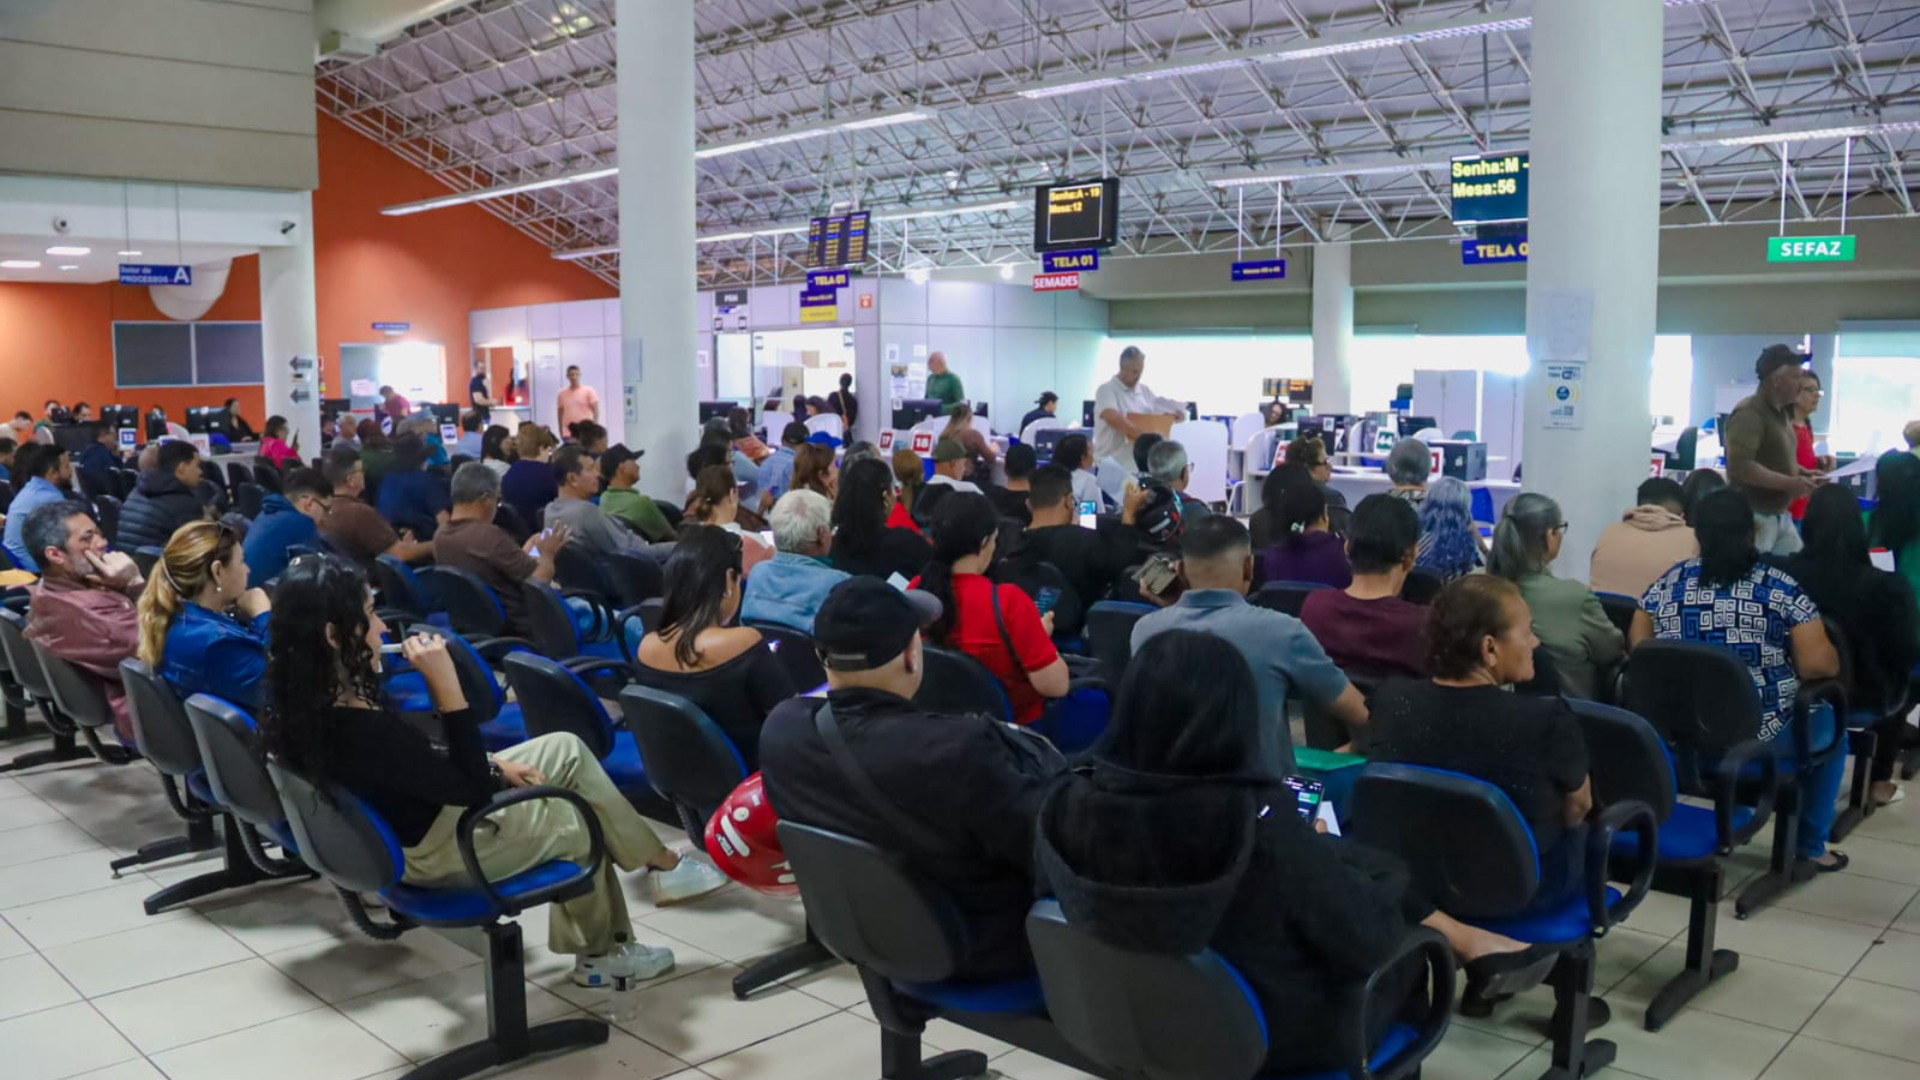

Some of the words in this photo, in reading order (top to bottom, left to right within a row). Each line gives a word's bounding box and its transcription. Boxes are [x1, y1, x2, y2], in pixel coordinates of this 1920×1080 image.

[1452, 156, 1519, 177] Senha:M
[1452, 178, 1516, 198] Mesa:56
[1476, 243, 1516, 258] TELA
[1519, 242, 1528, 256] 0
[1780, 241, 1842, 257] SEFAZ
[1052, 256, 1079, 268] TELA
[1080, 255, 1093, 266] 01
[121, 275, 168, 284] PROCESSOS
[173, 267, 190, 284] A
[814, 276, 835, 286] TELA
[1034, 275, 1077, 289] SEMADES
[881, 435, 891, 445] 17
[916, 437, 928, 448] 18
[1376, 436, 1393, 446] 44
